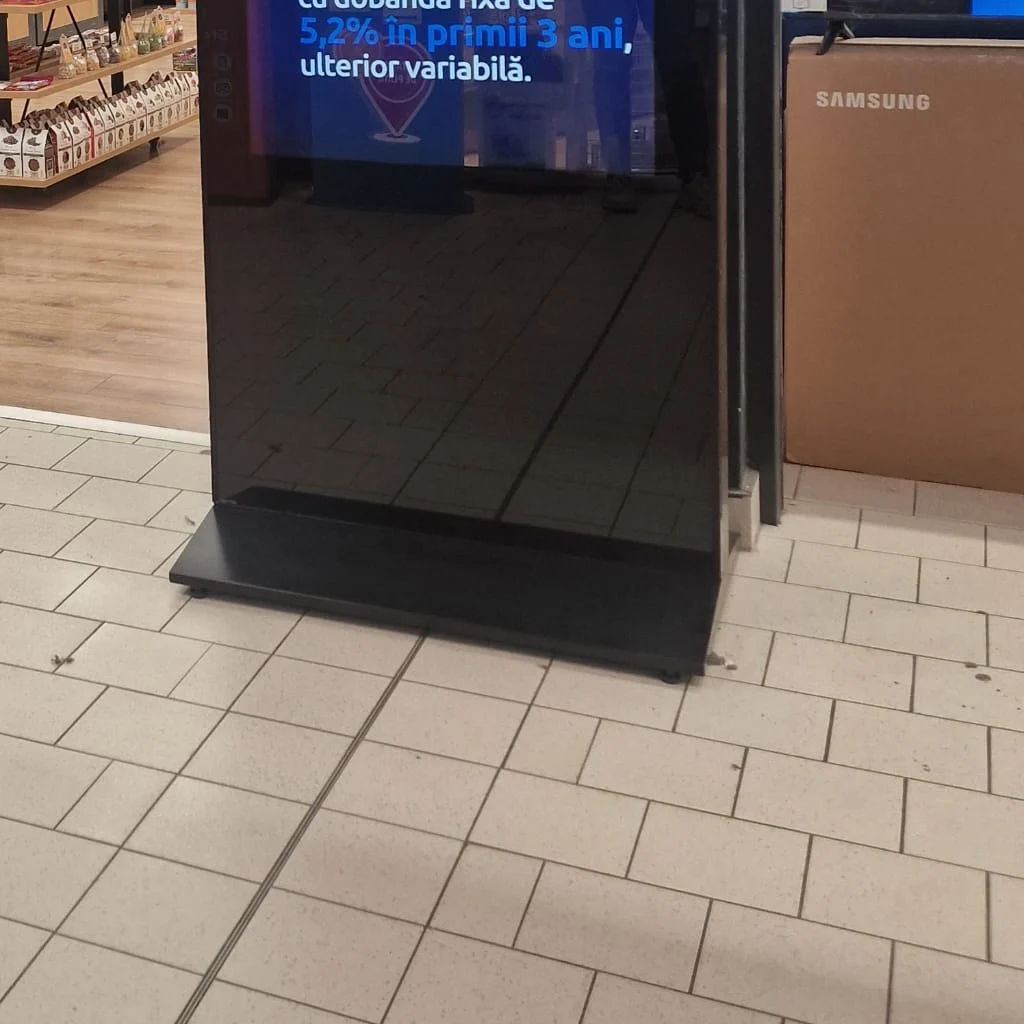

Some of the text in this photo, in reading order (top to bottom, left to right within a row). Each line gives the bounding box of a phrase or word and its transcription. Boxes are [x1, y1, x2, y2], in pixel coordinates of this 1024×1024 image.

[299, 16, 632, 55] 5,2% în primii 3 ani,
[300, 52, 532, 82] ulterior variabilă.
[816, 91, 930, 110] SAMSUNG
